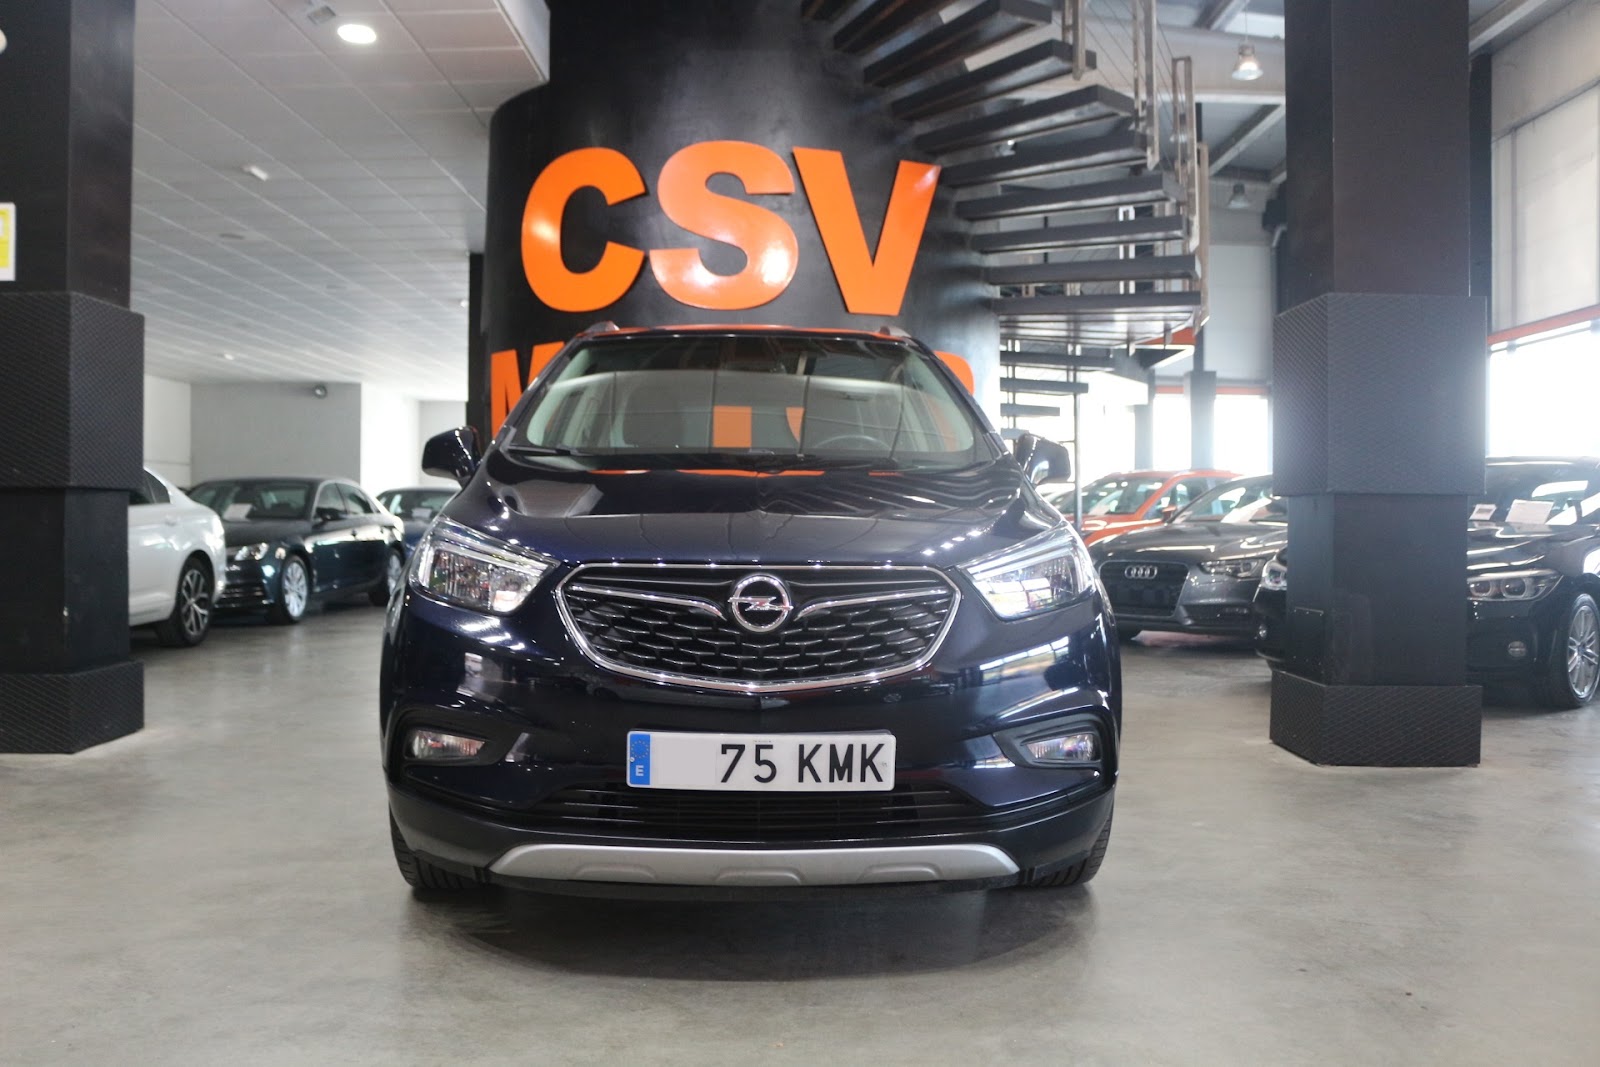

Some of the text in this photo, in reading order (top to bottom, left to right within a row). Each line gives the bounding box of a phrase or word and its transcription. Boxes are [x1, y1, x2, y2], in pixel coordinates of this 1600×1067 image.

[521, 140, 941, 316] CSV
[635, 765, 644, 777] E
[720, 743, 885, 784] 75 KMK
